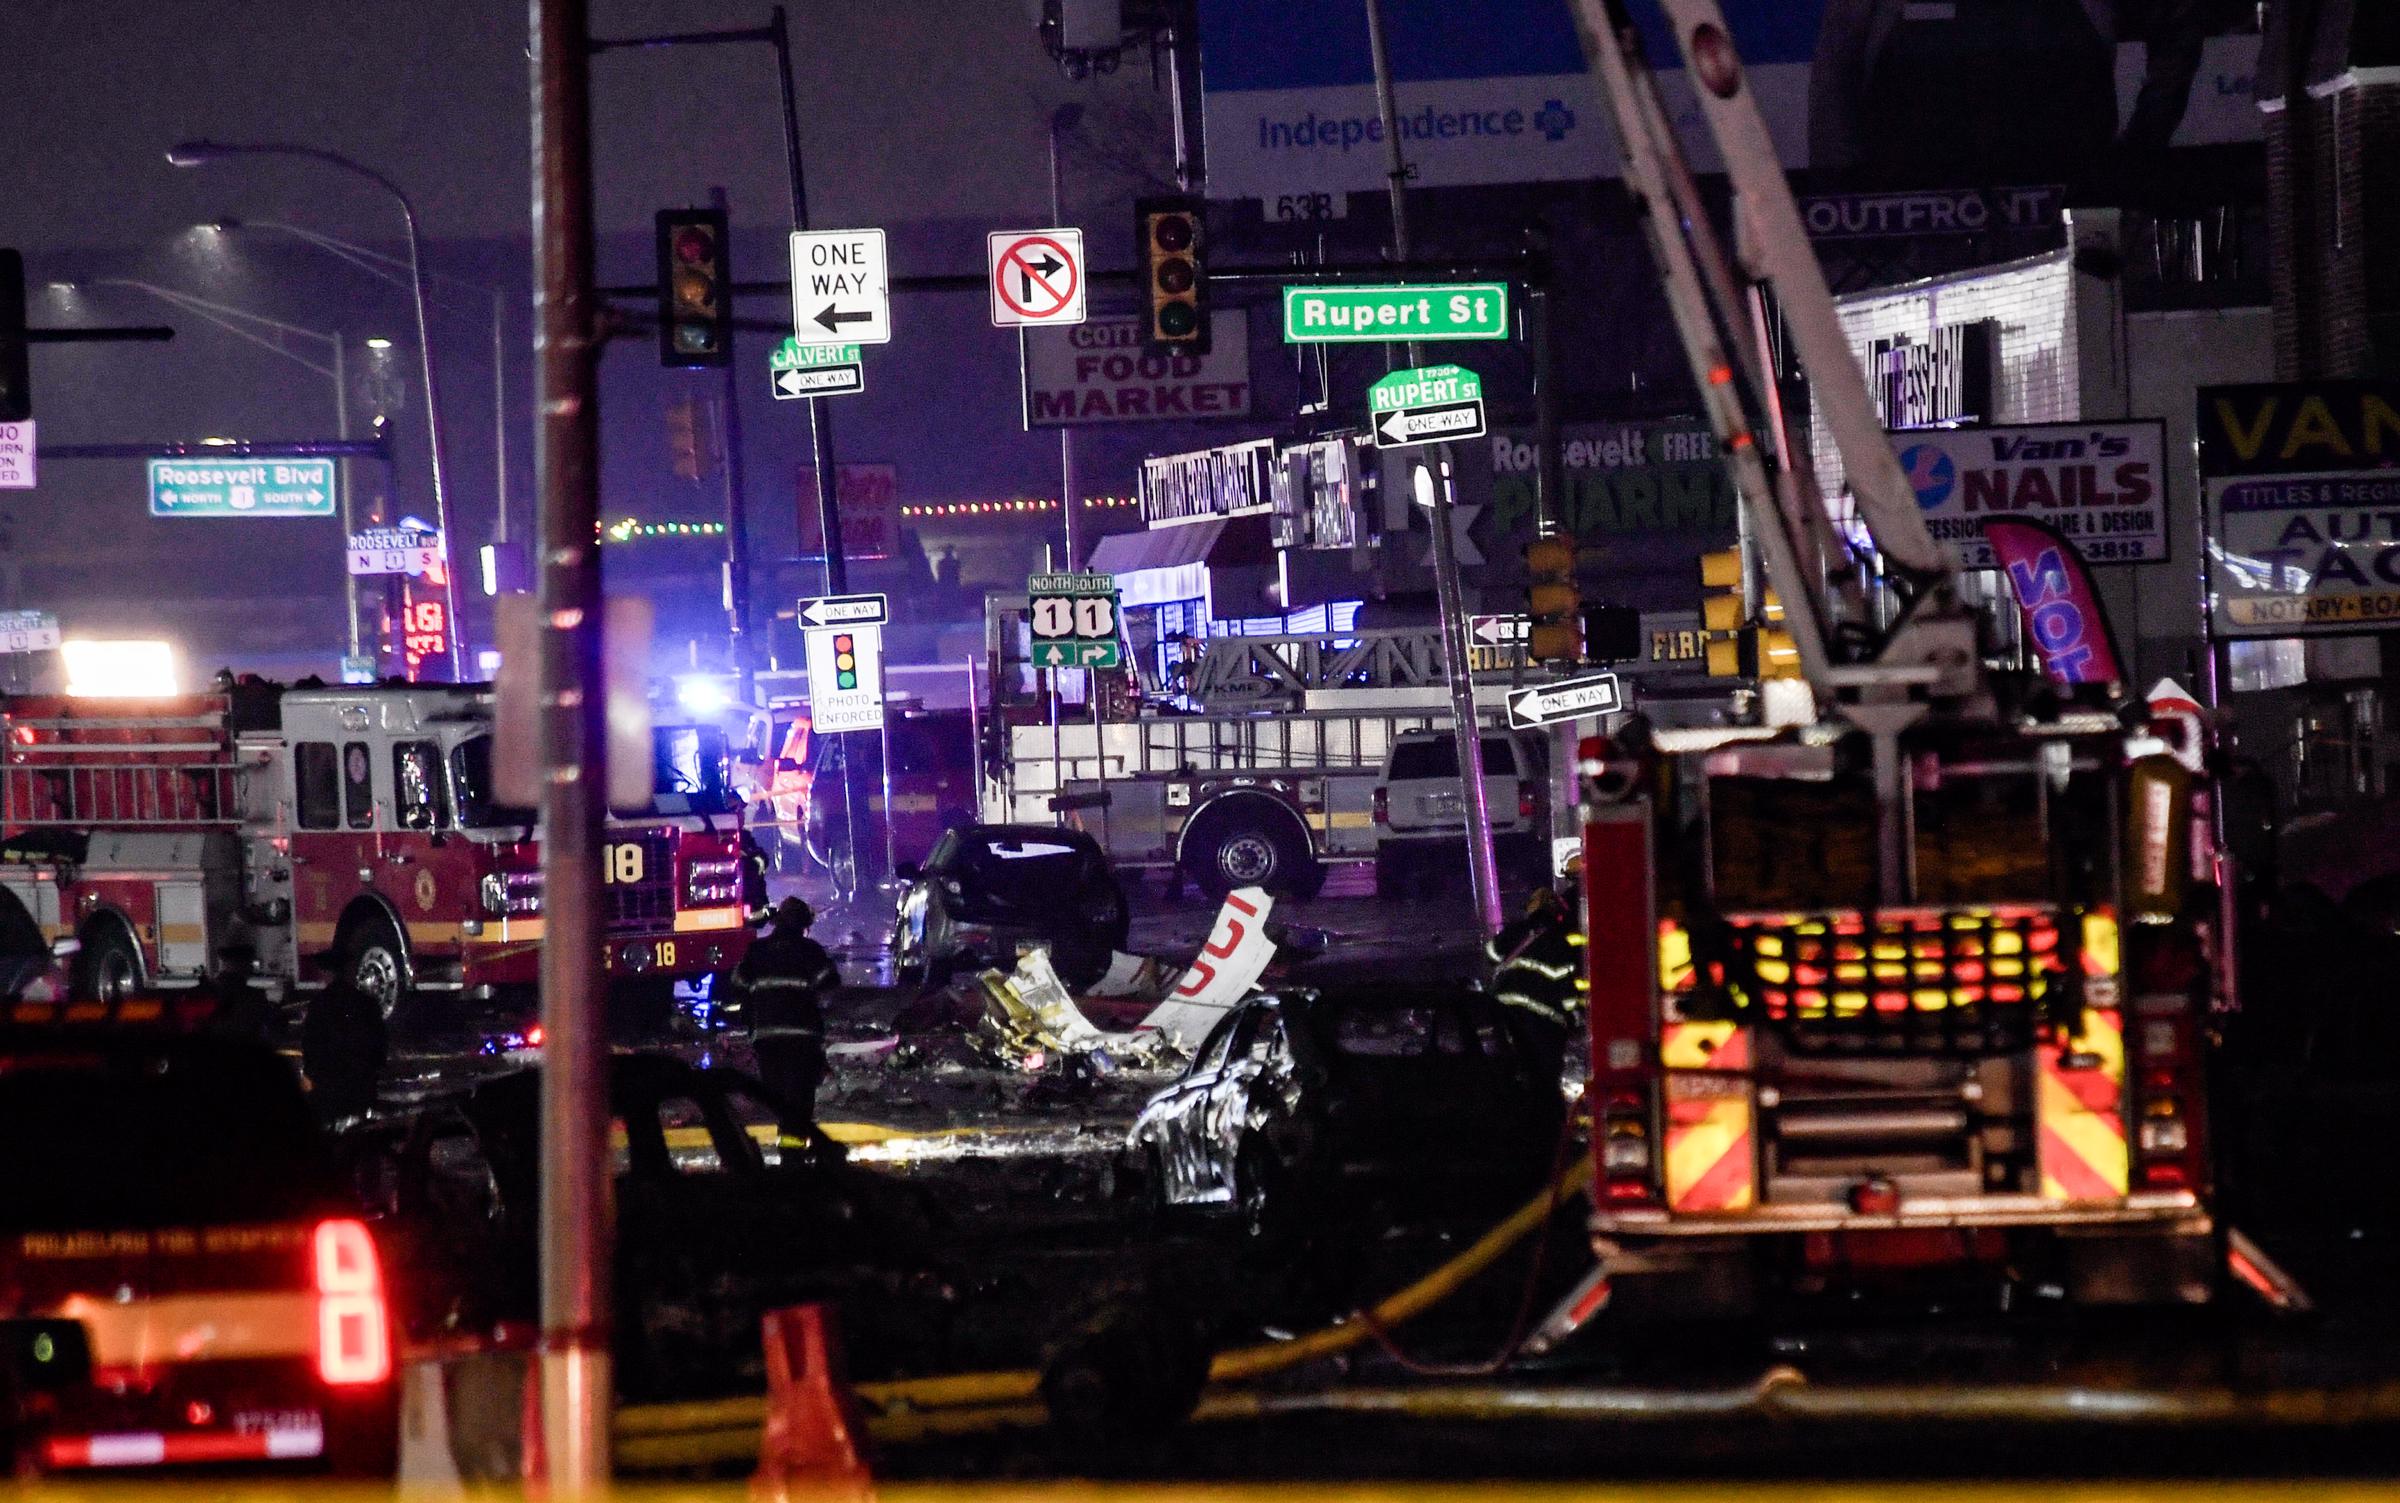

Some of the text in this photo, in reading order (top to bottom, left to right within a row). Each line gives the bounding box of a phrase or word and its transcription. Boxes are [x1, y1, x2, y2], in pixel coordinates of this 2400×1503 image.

[1259, 106, 1524, 151] Independence
[812, 243, 865, 266] ONE
[812, 273, 867, 296] WAY
[1303, 295, 1488, 331] Rupert St
[1072, 323, 1140, 348] COTT
[773, 345, 860, 367] CALVERT ST
[800, 371, 851, 387] ONE WAY
[1076, 353, 1202, 384] FOOD
[1034, 383, 1248, 418] MARKET
[1376, 378, 1477, 409] RUPERT ST
[1408, 412, 1470, 432] ONE WAY
[1662, 432, 1712, 462] FREE
[1991, 432, 2131, 461] Van's
[159, 466, 324, 485] Roosevelt Blvd
[181, 493, 222, 504] NORTH
[264, 492, 304, 504] SOUTH
[1962, 463, 2152, 512] NAILS
[2240, 485, 2310, 505] TITLES
[2320, 484, 2332, 501] &
[2087, 513, 2096, 533] &
[2102, 511, 2154, 532] DESIGN
[349, 533, 418, 550] ROOSEVELT
[359, 555, 369, 568] N
[422, 552, 432, 565] S
[1032, 577, 1110, 590] NORTH SOUTH
[825, 604, 876, 618] ONE WAY
[1046, 604, 1096, 630] 1 1
[2252, 597, 2344, 619] NOTARY
[828, 694, 870, 707] PHOTO
[1541, 688, 1607, 711] ONE WAY
[818, 710, 882, 725] ENFORCED
[604, 843, 643, 884] 18
[655, 941, 676, 967] 18
